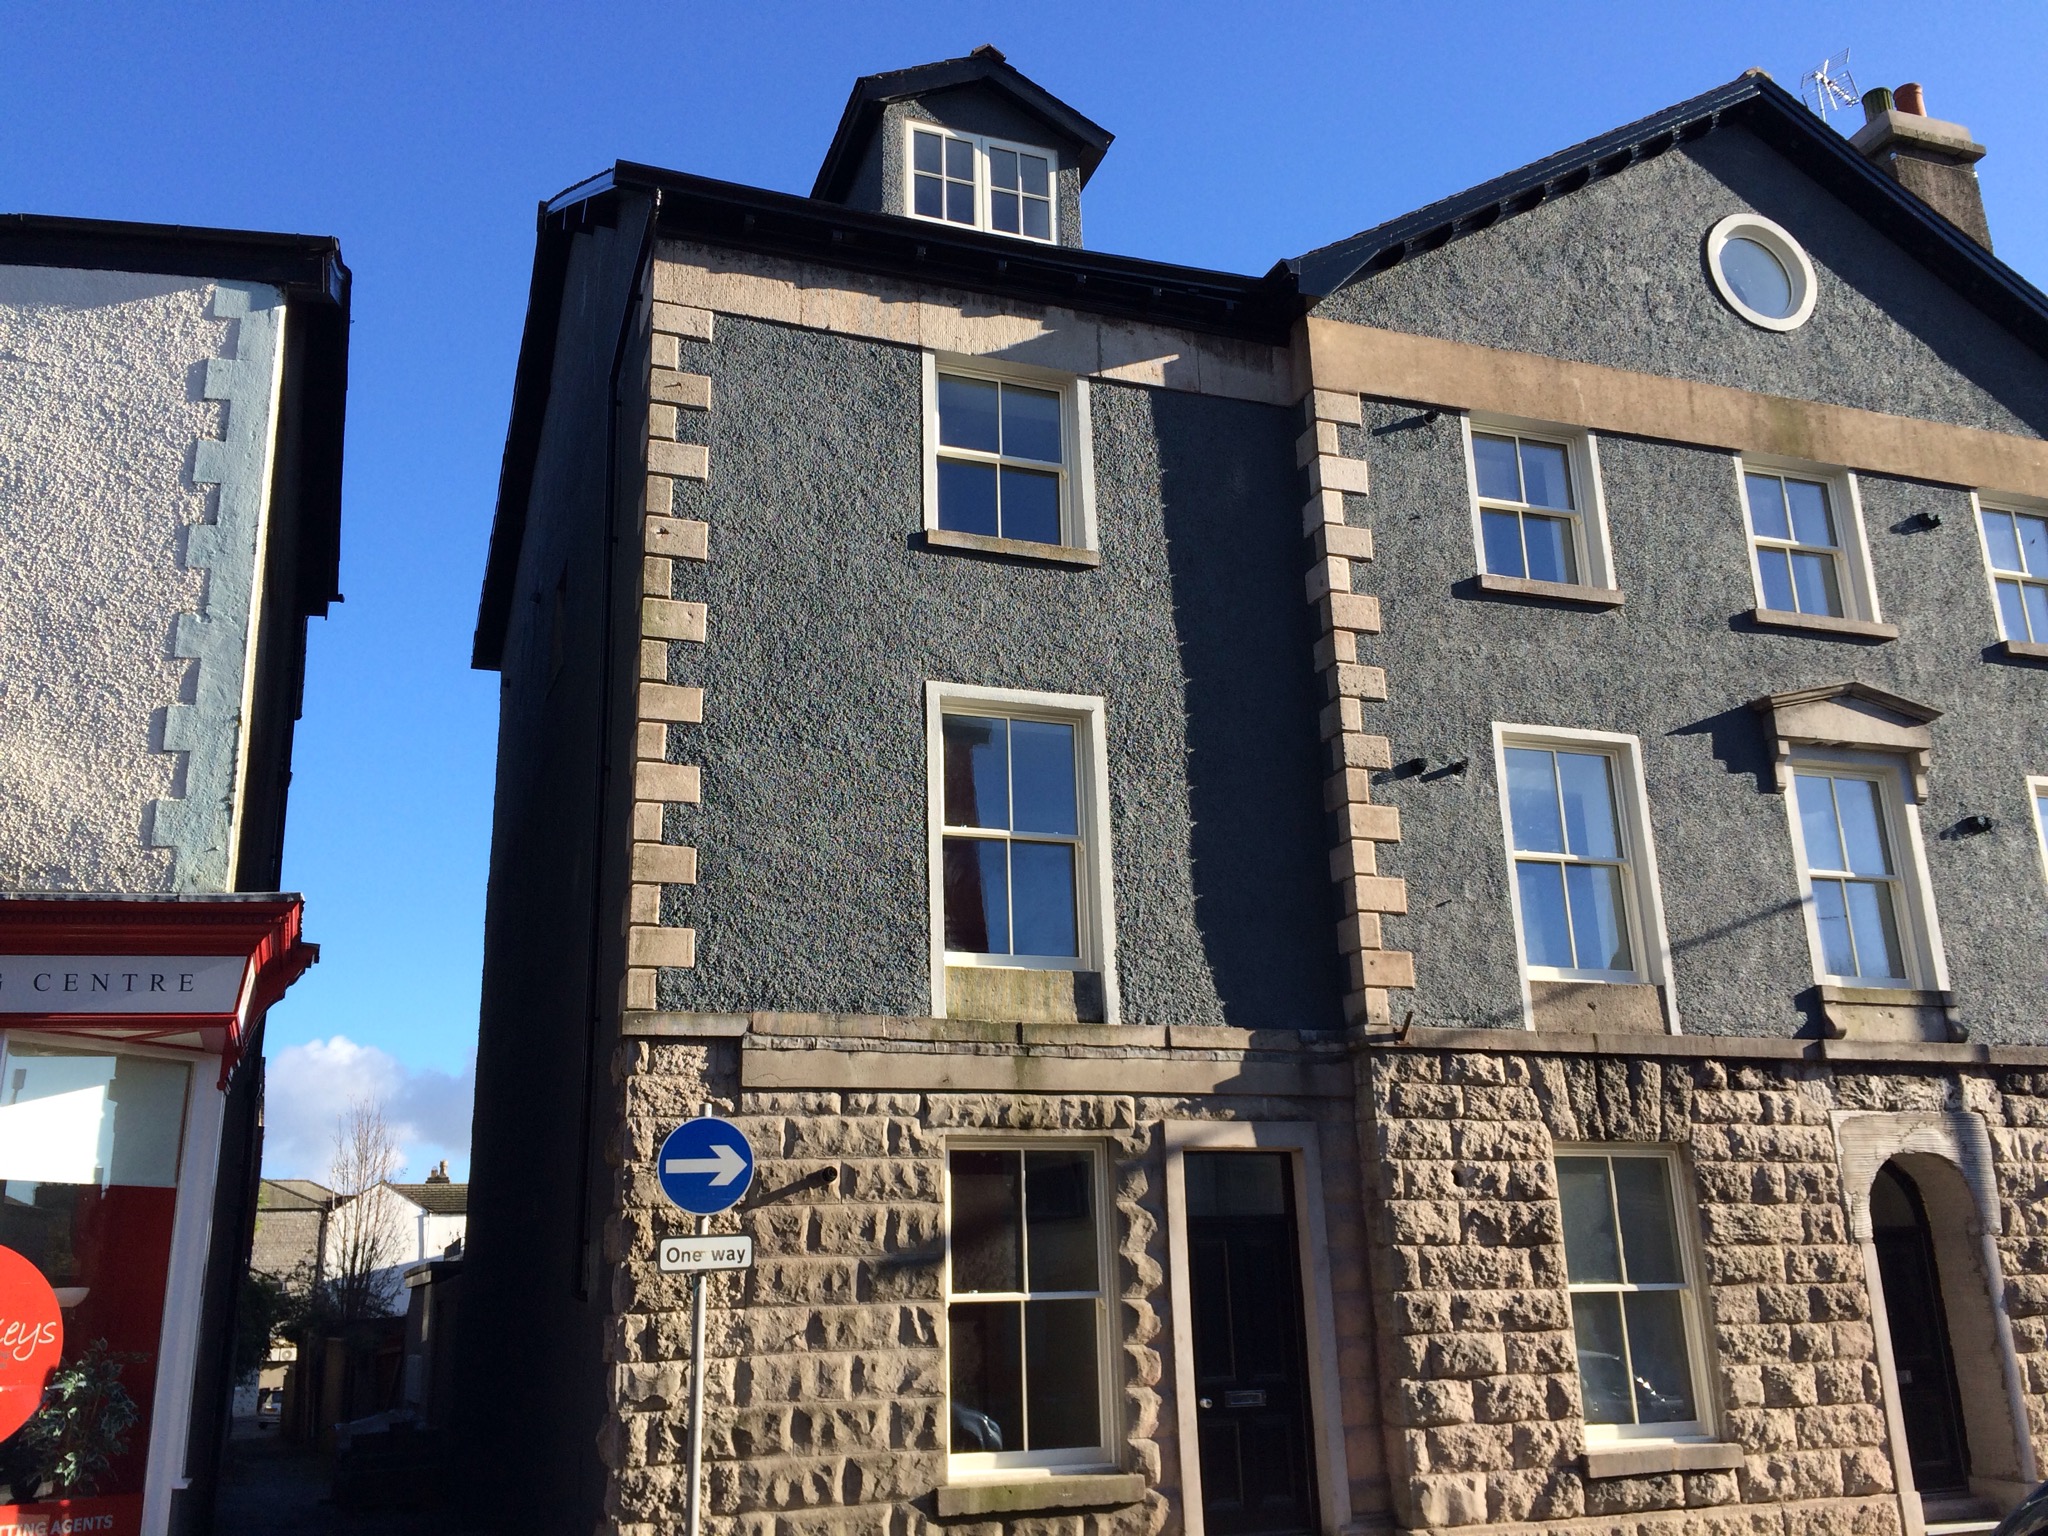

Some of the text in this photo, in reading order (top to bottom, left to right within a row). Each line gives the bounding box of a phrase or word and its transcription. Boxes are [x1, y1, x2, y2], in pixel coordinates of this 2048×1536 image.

[33, 972, 194, 992] CENTRE
[666, 1247, 746, 1264] One way
[50, 1515, 113, 1535] AGENTS
